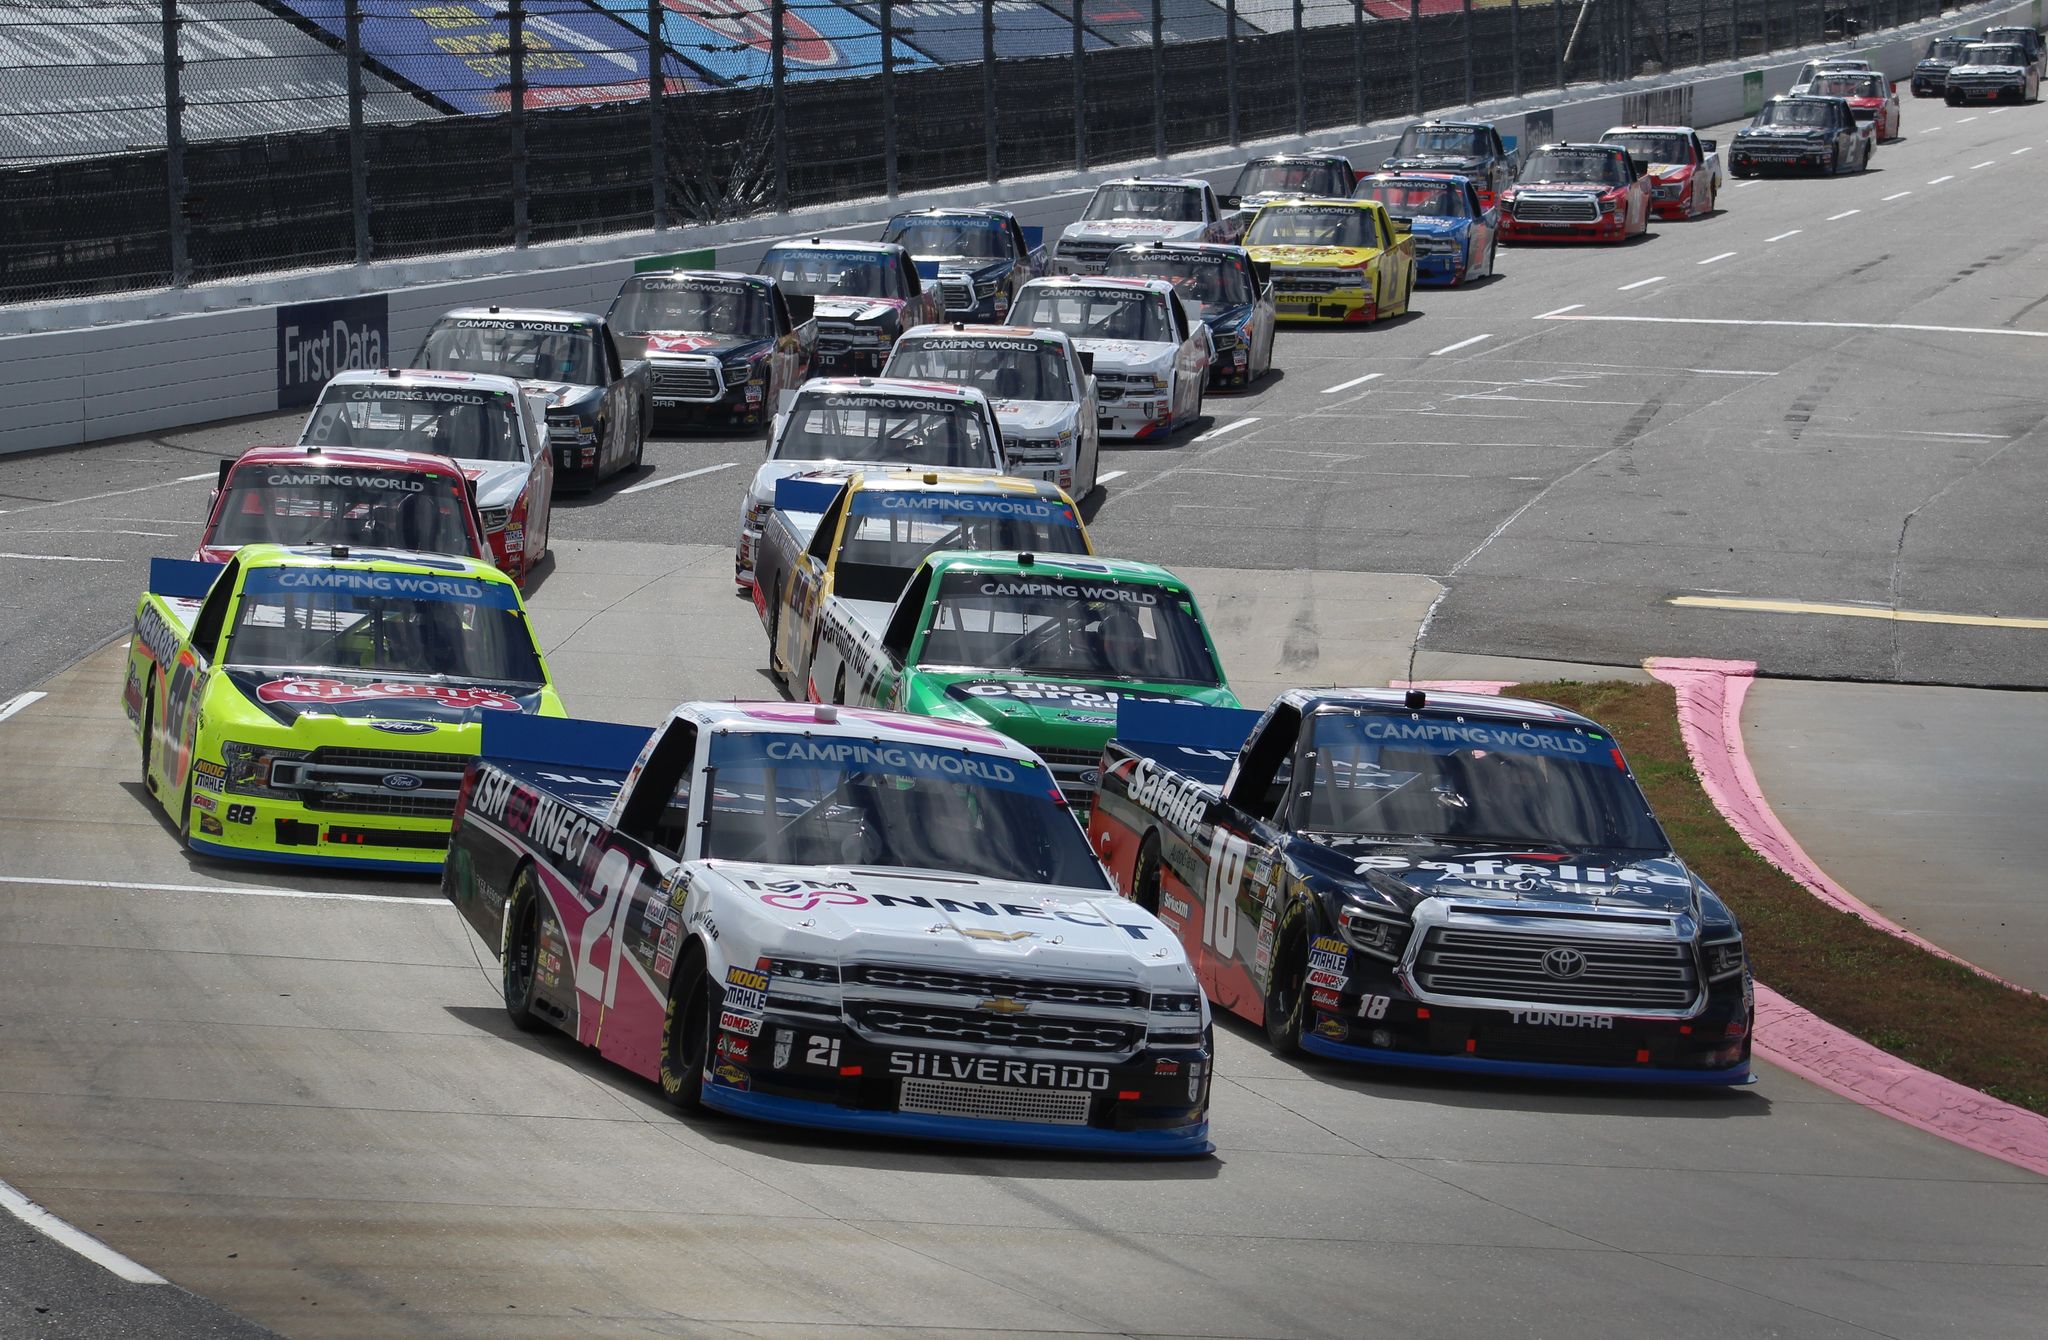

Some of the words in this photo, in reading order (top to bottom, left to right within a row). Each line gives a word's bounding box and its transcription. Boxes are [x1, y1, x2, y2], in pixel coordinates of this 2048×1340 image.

[905, 219, 950, 227] CAMPING
[951, 220, 989, 228] WORLD
[783, 252, 835, 260] CAMPING
[835, 253, 877, 263] WORLD
[1180, 255, 1222, 264] WORLD
[644, 282, 698, 291] CAMPING
[699, 284, 744, 295] WORLD
[1039, 289, 1096, 298] CAMPING
[1097, 291, 1145, 300] WORLD
[457, 320, 515, 330] CAMPING
[520, 322, 569, 333] WORLD
[922, 341, 985, 350] CAMPING
[988, 342, 1038, 351] WORLD
[351, 390, 421, 400] CAMPING
[424, 392, 483, 404] WORLD
[825, 397, 896, 409] CAMPING
[896, 399, 956, 412] WORLD
[267, 474, 353, 486] CAMPING
[355, 477, 424, 492] WORLD
[881, 497, 974, 512] CAMPING
[977, 500, 1050, 517] WORLD
[278, 572, 391, 591] CAMPING
[395, 578, 482, 599] WORLD
[980, 583, 1080, 601] CAMPING
[1082, 588, 1157, 606] WORLD
[1007, 681, 1086, 693] The
[380, 721, 426, 732] Ford
[1364, 722, 1489, 744] CAMPING
[1493, 730, 1587, 755] WORLD
[194, 759, 226, 778] MOOG
[765, 741, 906, 767] CAMPING
[909, 751, 1015, 783] WORLD
[390, 775, 414, 787] Ford
[472, 766, 514, 822] ISM
[1127, 757, 1207, 836] Safelite
[226, 803, 257, 825] 88
[1353, 855, 1692, 887] Safelite
[743, 879, 859, 894] ISM
[1203, 826, 1248, 959] 18
[575, 847, 647, 1010] 21
[1311, 936, 1350, 955] MOOG
[1309, 952, 1347, 973] MAHLE
[727, 968, 769, 991] MOOG
[726, 986, 766, 1010] MAHLE
[1357, 993, 1391, 1020] 18
[721, 1012, 750, 1030] COMP
[1507, 1008, 1614, 1030] TUNDRA
[806, 1034, 841, 1068] 21
[716, 1067, 749, 1081] SUNOCO
[888, 1050, 1110, 1090] SILVERADO
